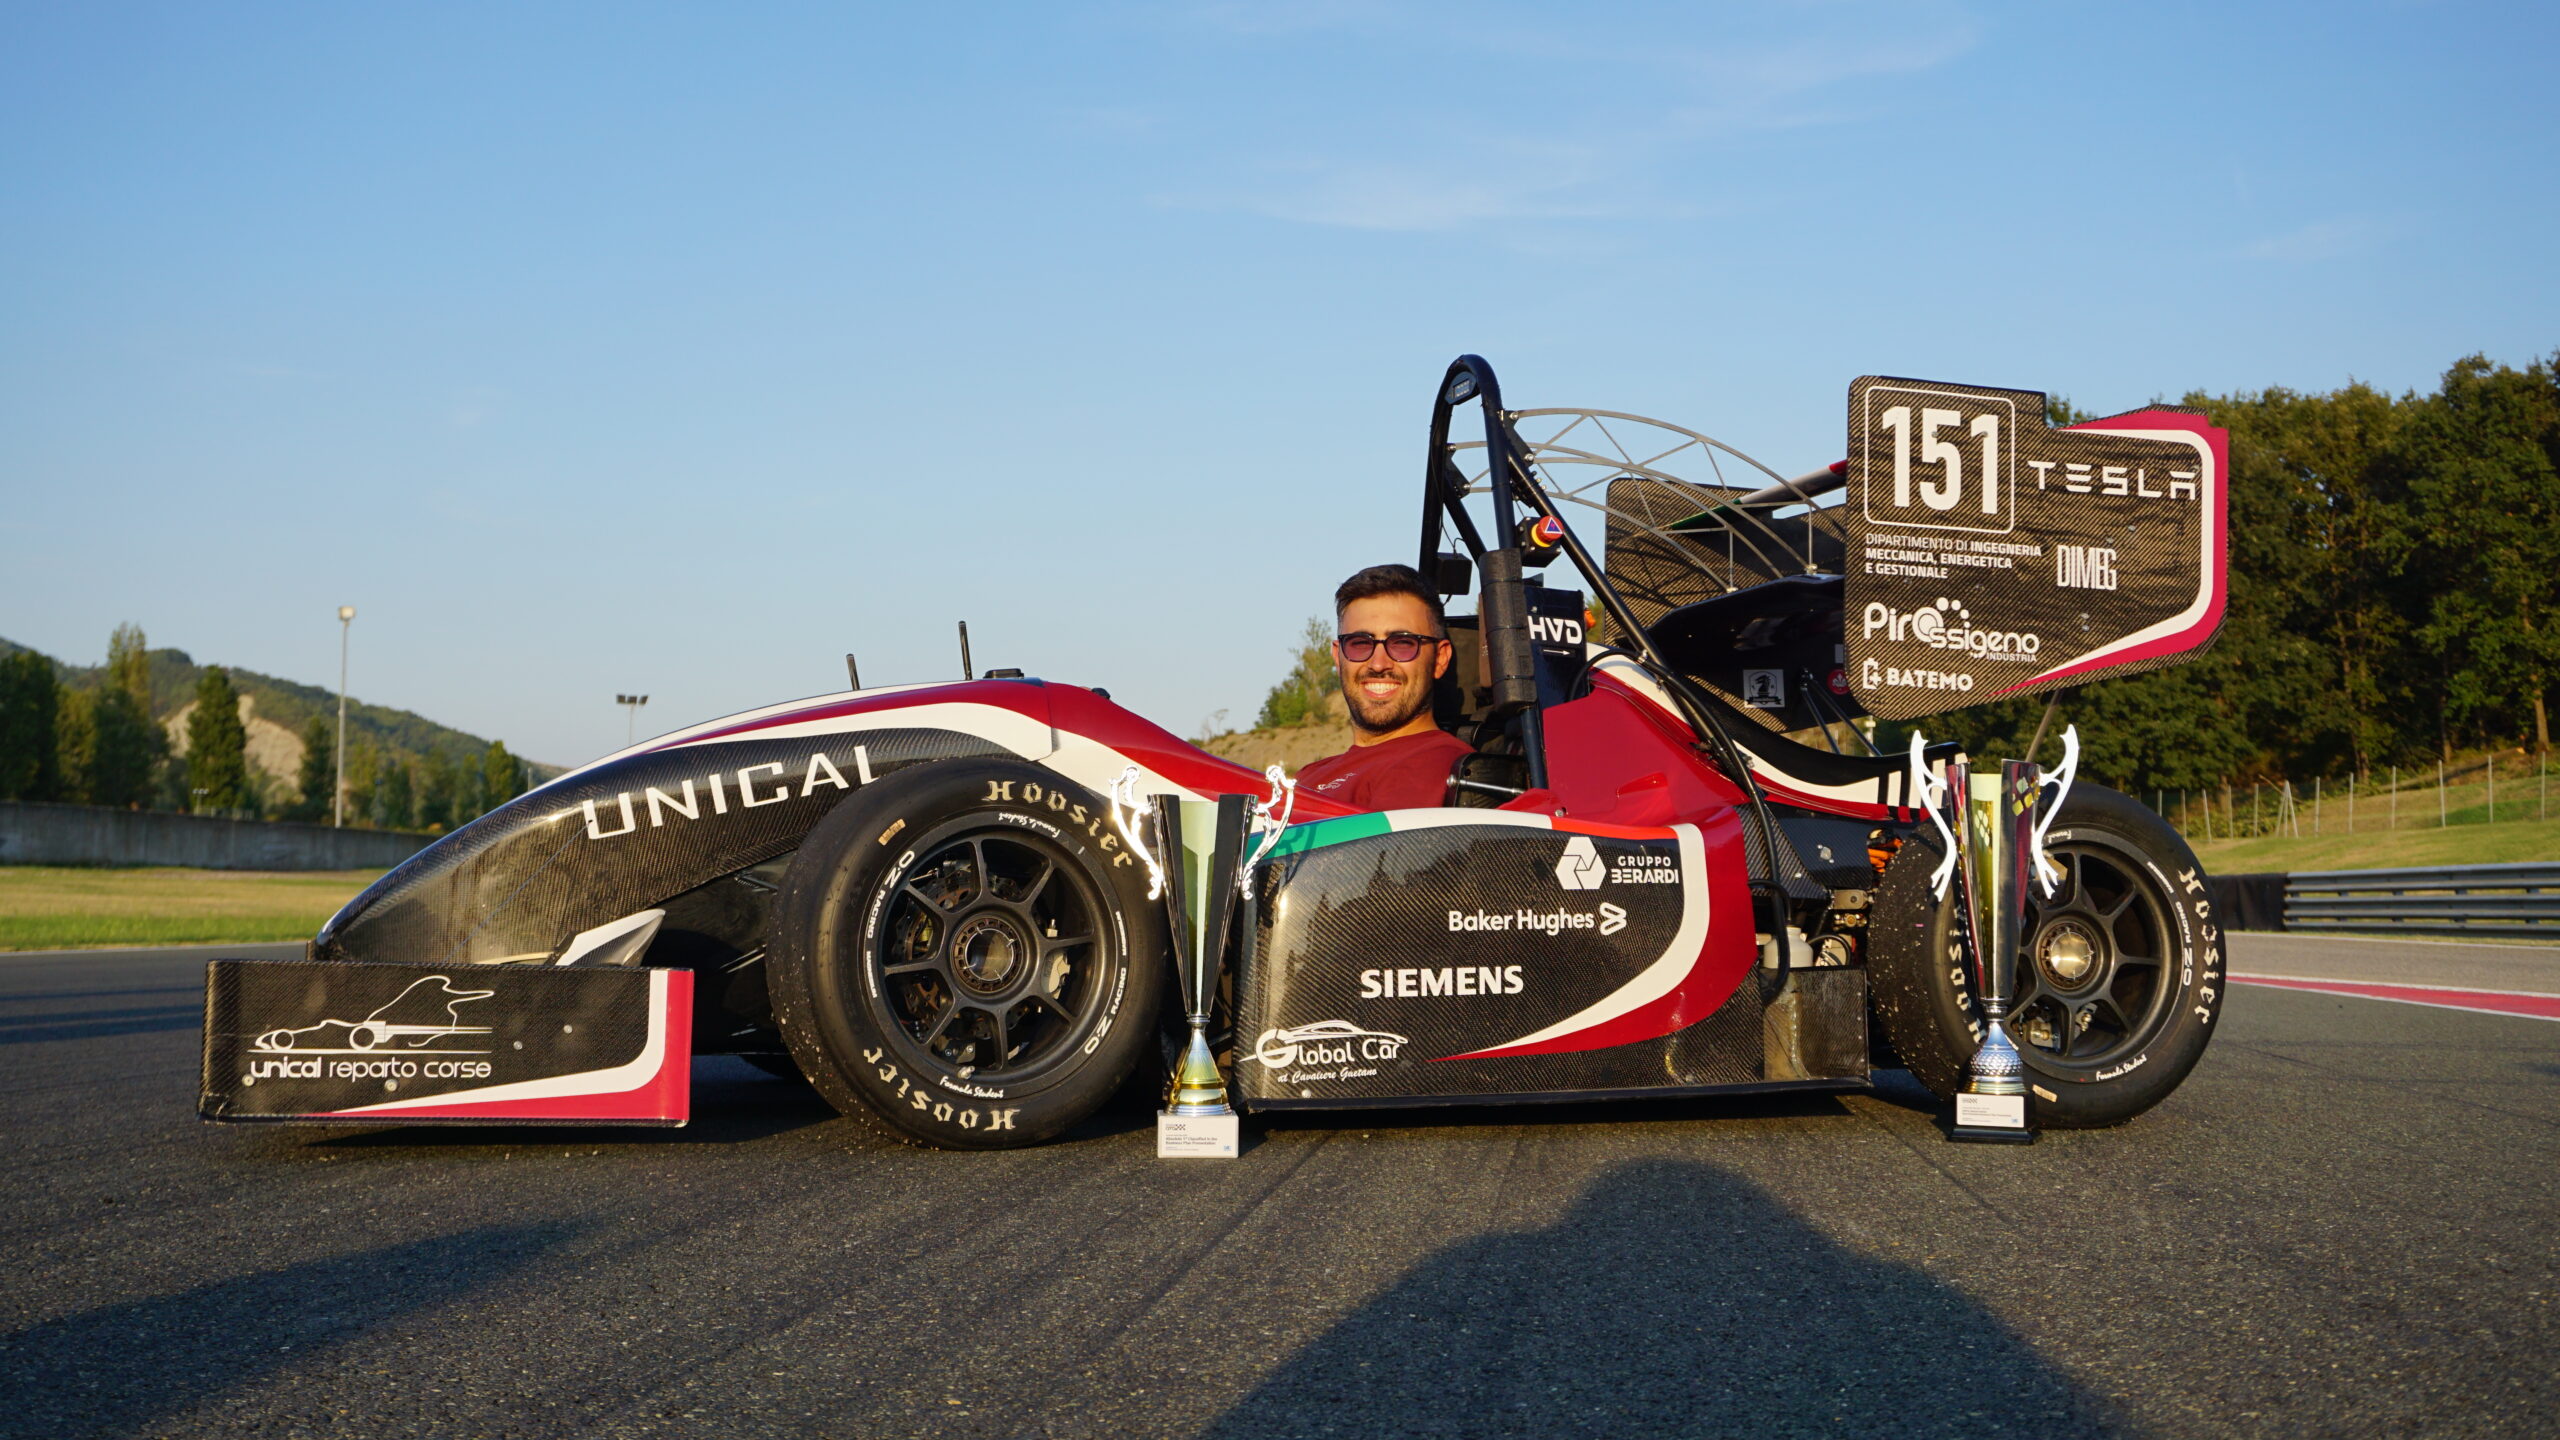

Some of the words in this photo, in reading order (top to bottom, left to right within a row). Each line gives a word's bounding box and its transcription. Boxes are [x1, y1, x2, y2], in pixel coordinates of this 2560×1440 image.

[1882, 405, 1999, 514] 151
[2027, 460, 2197, 501] TESLA
[1866, 533, 1953, 551] DIPARTIMENTO
[1956, 540, 1969, 552] DI
[1970, 541, 2042, 557] INGEGNERIA
[1866, 548, 1938, 565] MECCANICA,
[1940, 555, 2013, 569] ENERGETICA
[1865, 562, 1873, 574] E
[1875, 563, 1949, 579] GESTIONALE
[1527, 615, 1583, 645] HVD
[1986, 652, 2038, 663] INDUSTRIA
[1886, 667, 1974, 692] BATEMO
[582, 745, 879, 840] UNICAL
[1618, 856, 1672, 867] GRUPPO
[1611, 869, 1680, 884] BERARDI
[867, 889, 886, 939] RACING
[1449, 909, 1514, 932] Baker
[1517, 908, 1595, 936] Hughes
[1110, 967, 1127, 1015] RACING
[1360, 965, 1524, 999] SIEMENS
[1256, 1028, 1355, 1069] Global
[1362, 1038, 1400, 1060] Car
[250, 1056, 322, 1079] unical
[329, 1057, 417, 1083] reparto
[424, 1061, 492, 1079] corse
[1292, 1070, 1337, 1084] Cavaliere
